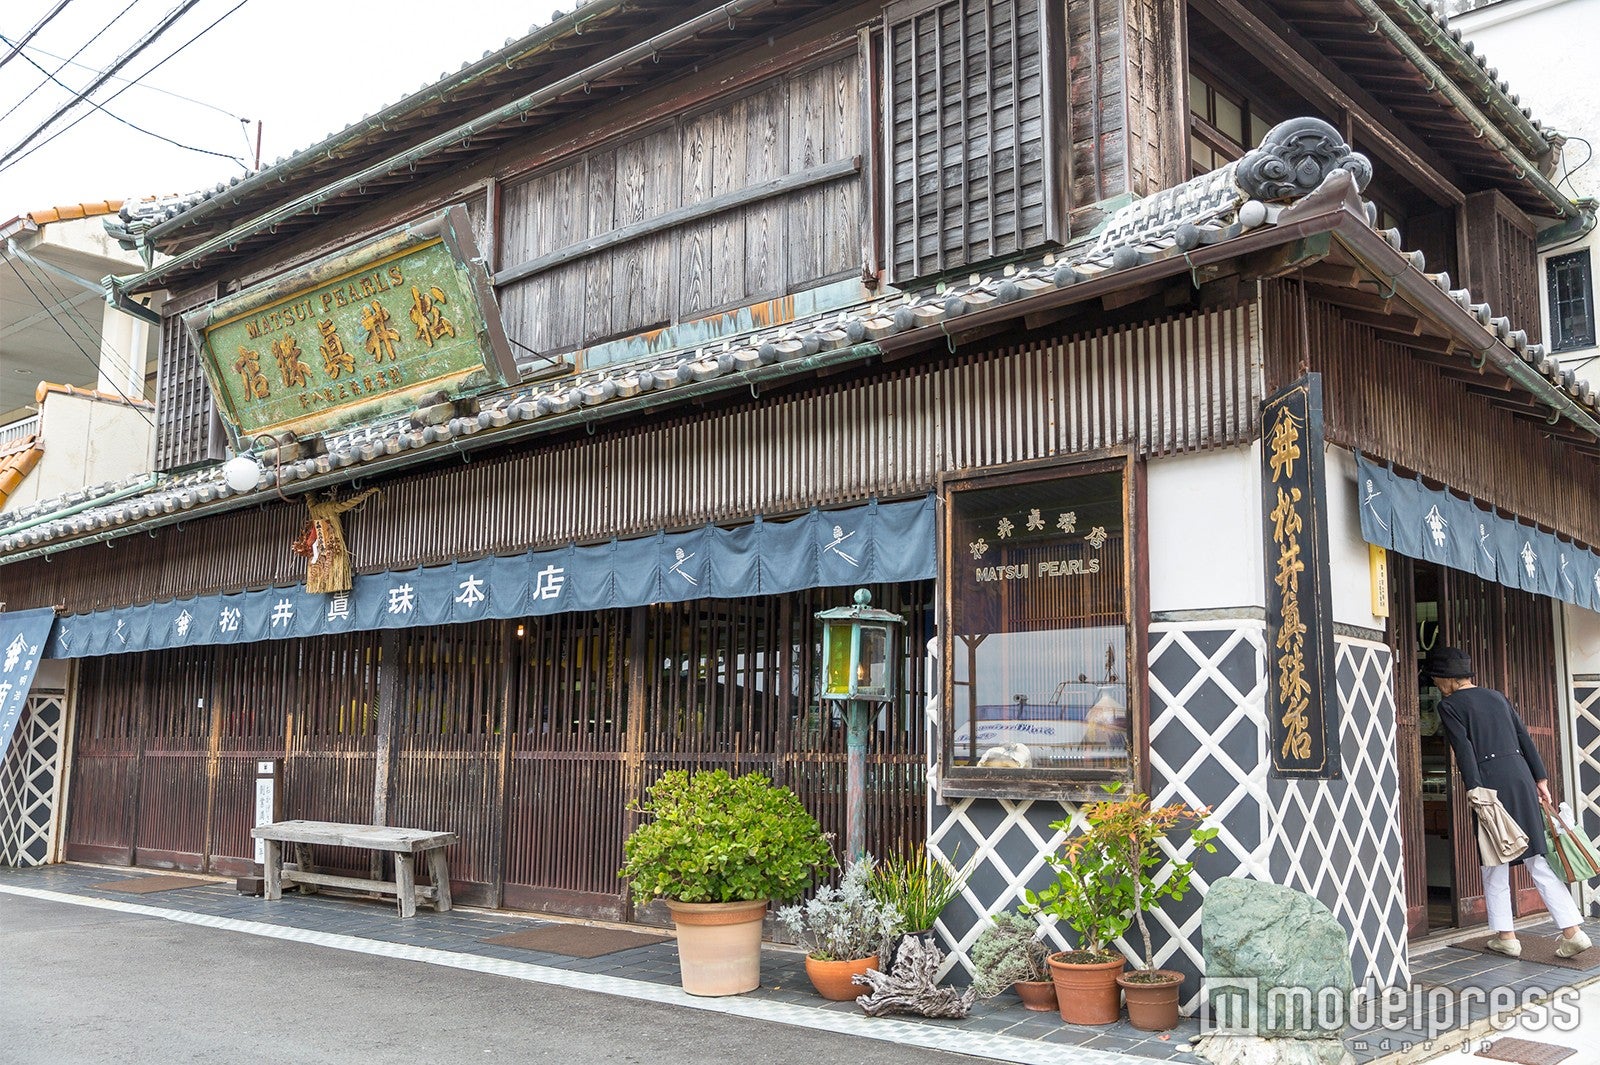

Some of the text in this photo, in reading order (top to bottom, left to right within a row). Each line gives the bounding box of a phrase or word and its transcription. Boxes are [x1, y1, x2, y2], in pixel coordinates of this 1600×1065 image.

[245, 266, 405, 339] MATSUI PEARLS
[975, 558, 1100, 582] MATSUI PEARLS
